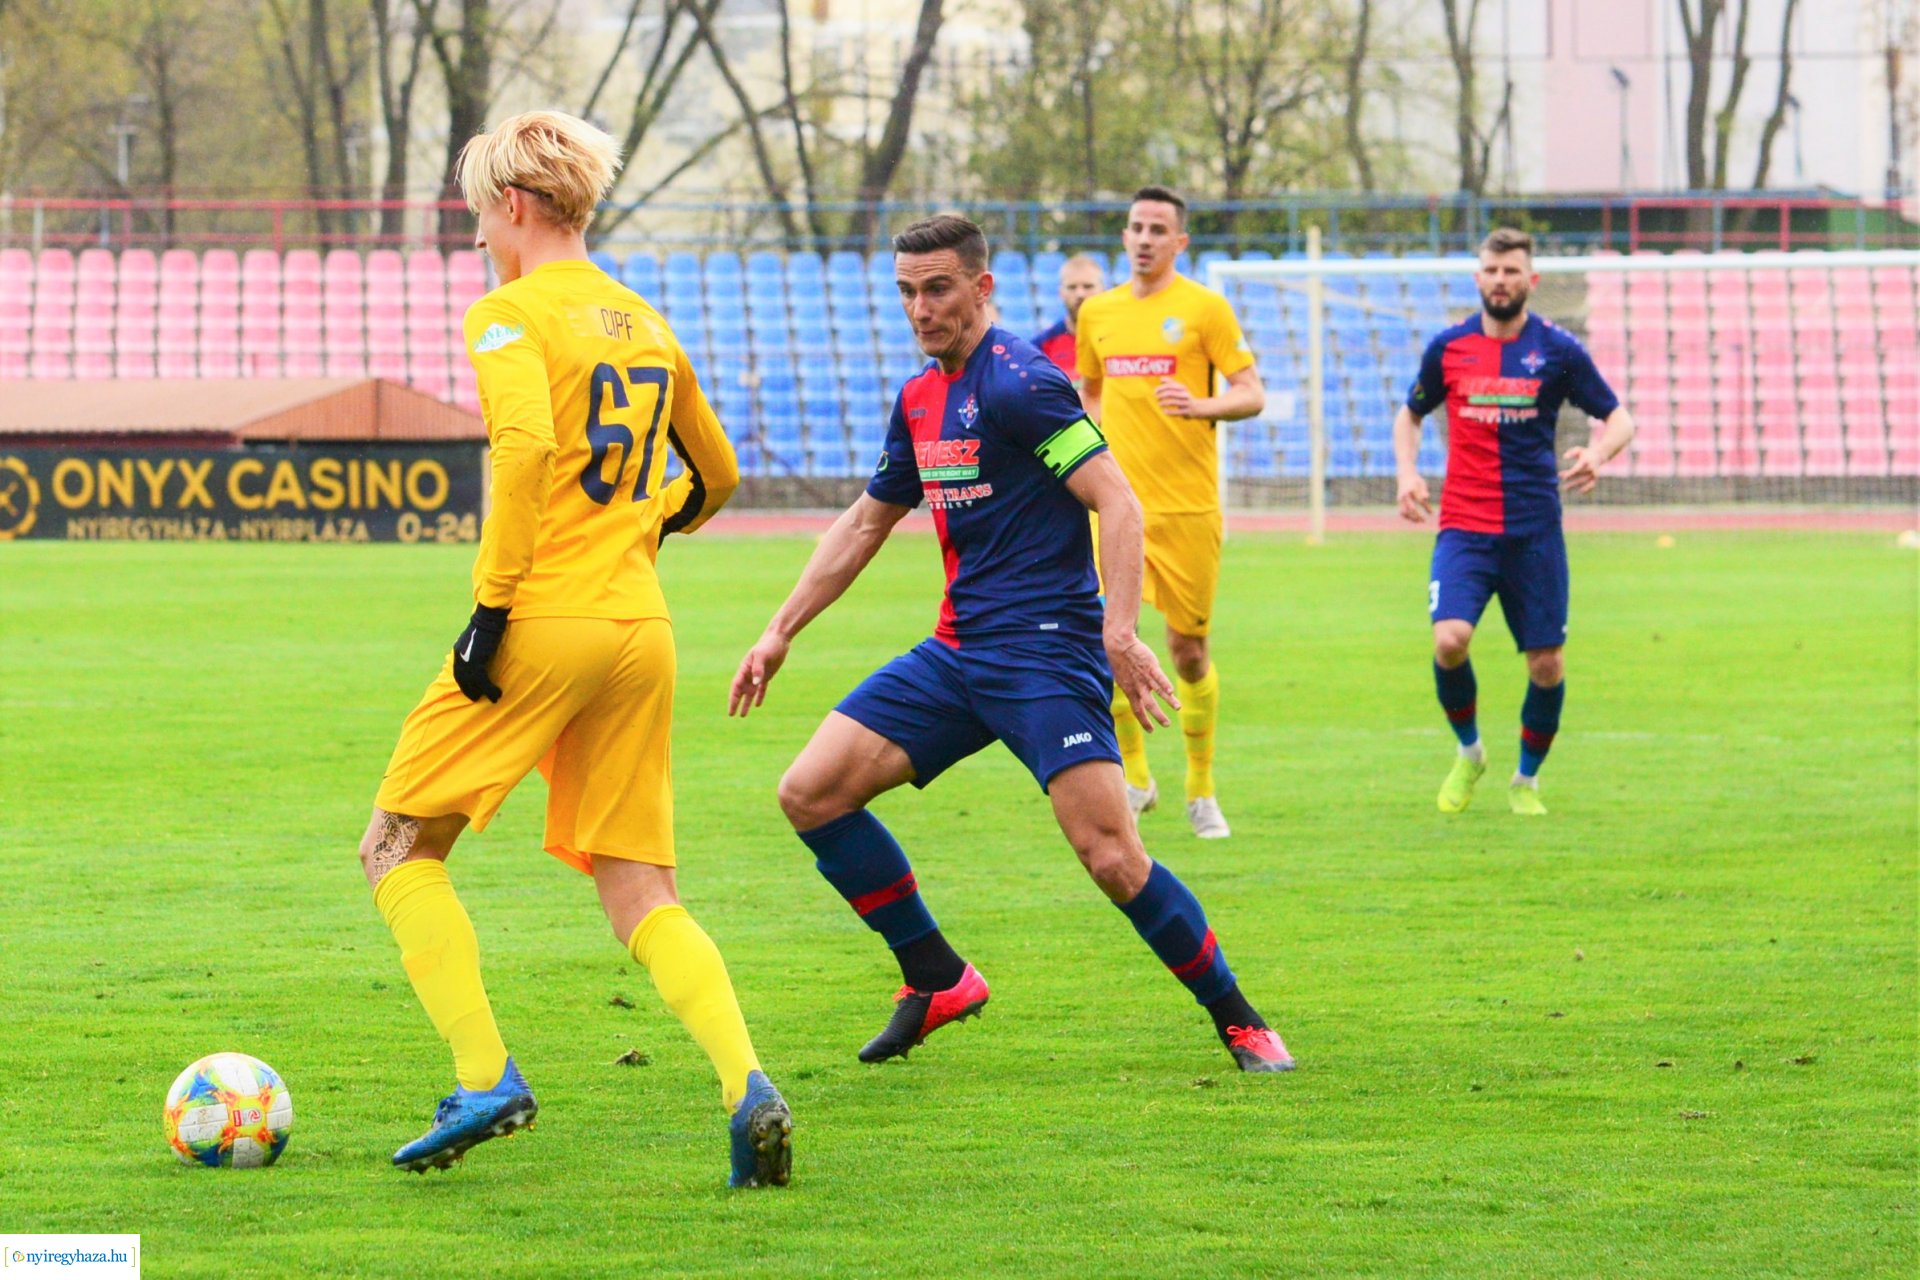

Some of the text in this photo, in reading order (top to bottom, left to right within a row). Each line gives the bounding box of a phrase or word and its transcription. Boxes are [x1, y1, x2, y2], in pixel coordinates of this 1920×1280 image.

[600, 308, 632, 341] CIPF
[580, 362, 669, 506] 67
[52, 457, 450, 511] ONYX CASINO
[396, 512, 477, 543] 0-24
[1063, 732, 1092, 748] JAKO
